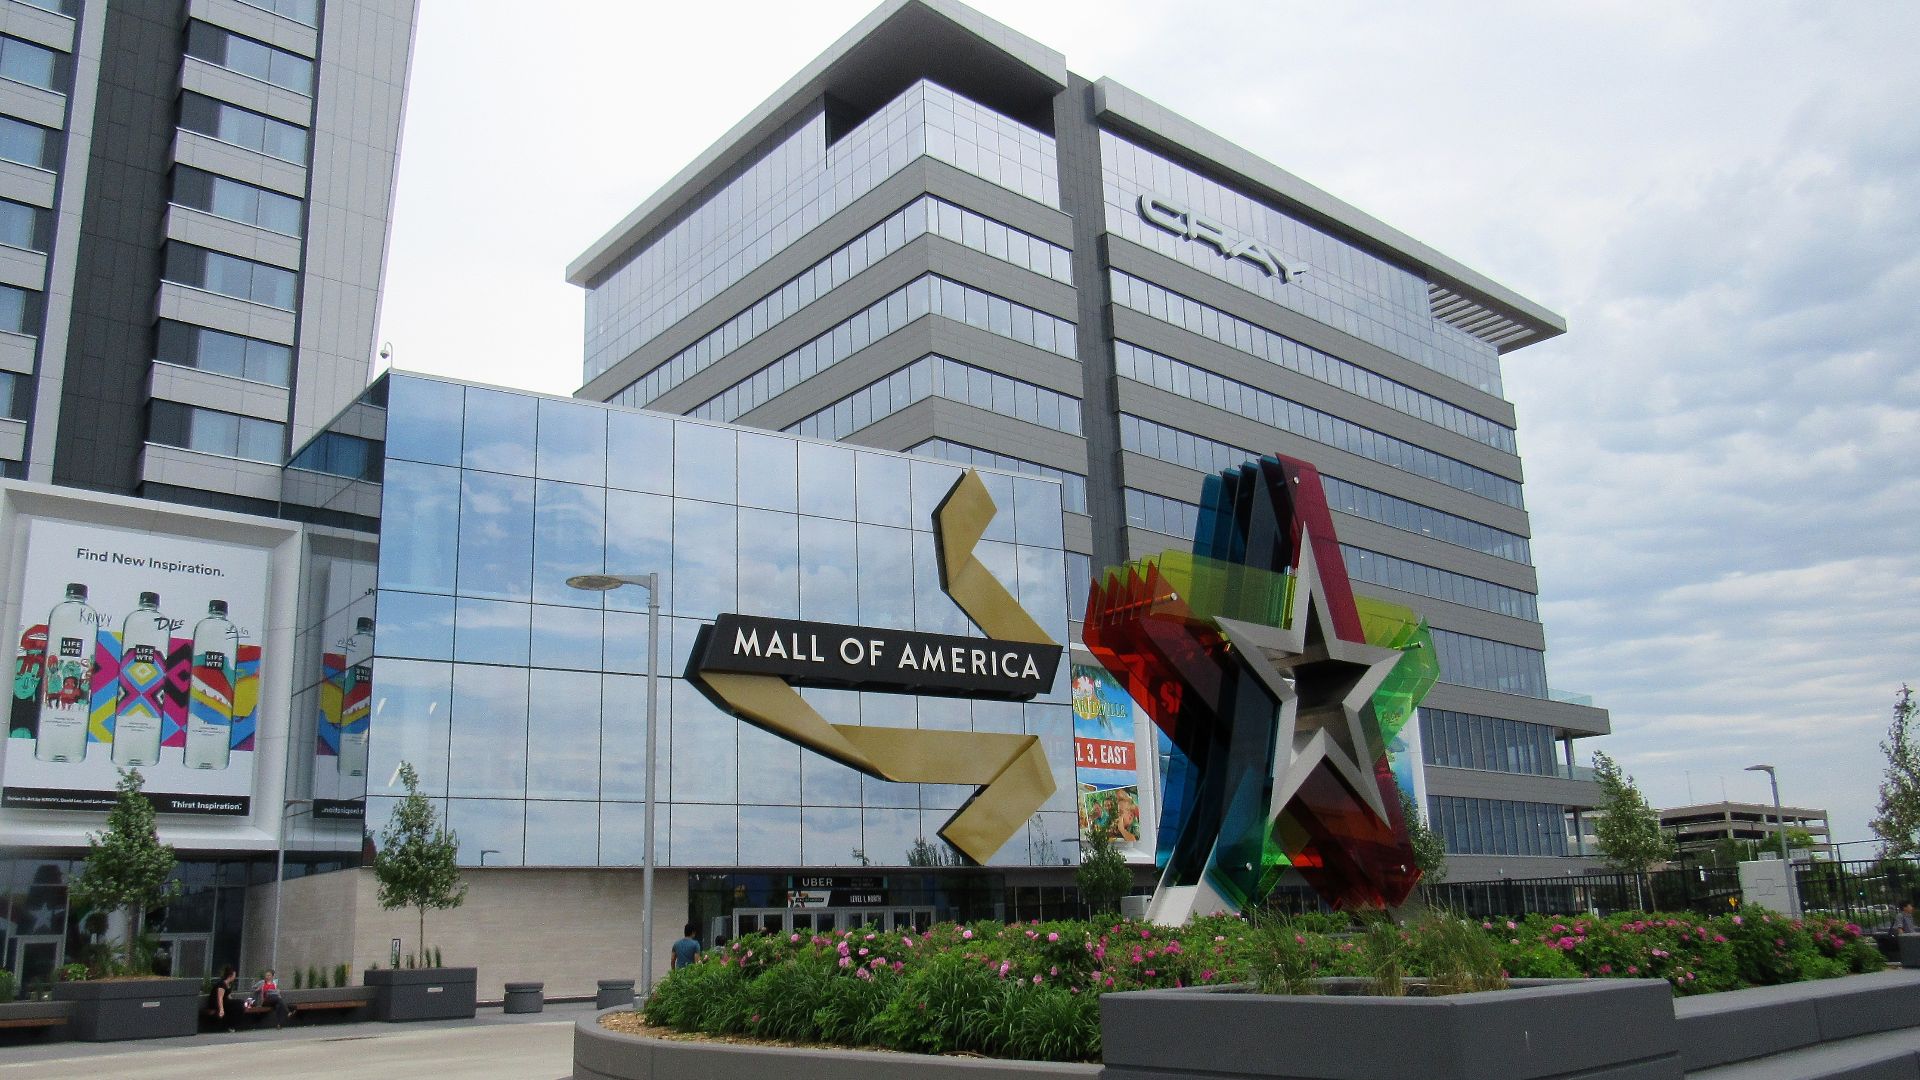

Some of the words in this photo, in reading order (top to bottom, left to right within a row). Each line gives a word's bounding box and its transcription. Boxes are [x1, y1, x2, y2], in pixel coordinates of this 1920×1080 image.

[1135, 193, 1309, 284] CRAY
[76, 547, 109, 563] Find
[112, 551, 146, 568] New
[149, 556, 225, 577] Inspiration.
[62, 640, 82, 648] LIFE
[62, 647, 81, 655] WTR
[136, 647, 154, 655] LIFE
[732, 625, 826, 663] MALL
[839, 636, 886, 667] OF
[898, 641, 1042, 681] AMERICA
[136, 654, 154, 662] WTR
[206, 653, 223, 661] LIFE
[206, 660, 222, 668] WTR
[1086, 743, 1097, 765] 3,
[1100, 744, 1128, 765] EAST
[171, 800, 195, 809] Thirst
[802, 877, 833, 887] UBER
